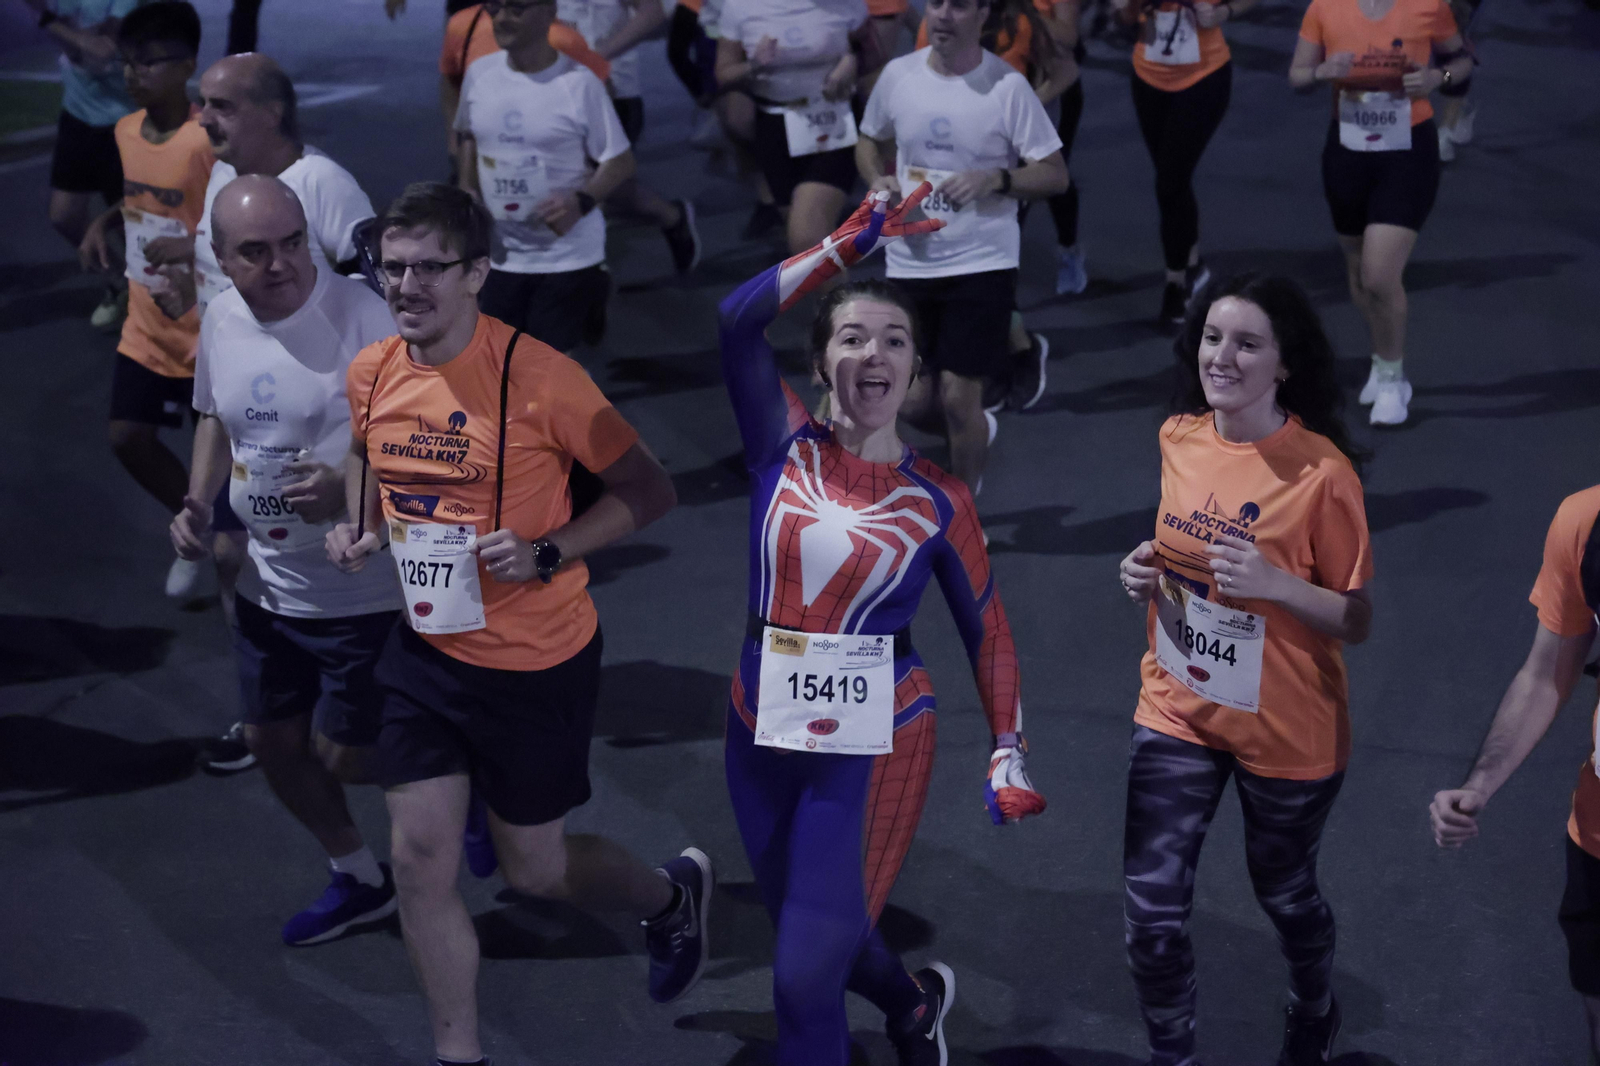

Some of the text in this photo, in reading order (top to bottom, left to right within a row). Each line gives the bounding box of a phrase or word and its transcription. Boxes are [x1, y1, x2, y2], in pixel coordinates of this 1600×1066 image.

[1354, 110, 1397, 126] 10966
[245, 407, 279, 422] Cenit
[381, 442, 434, 461] SEVILLA
[408, 433, 470, 450] NOCTURNA
[1163, 512, 1214, 544] SEVILLA
[1190, 509, 1257, 545] NOCTURNA
[401, 558, 454, 589] 12677
[1175, 618, 1237, 667] 18044
[787, 672, 868, 704] 15419
